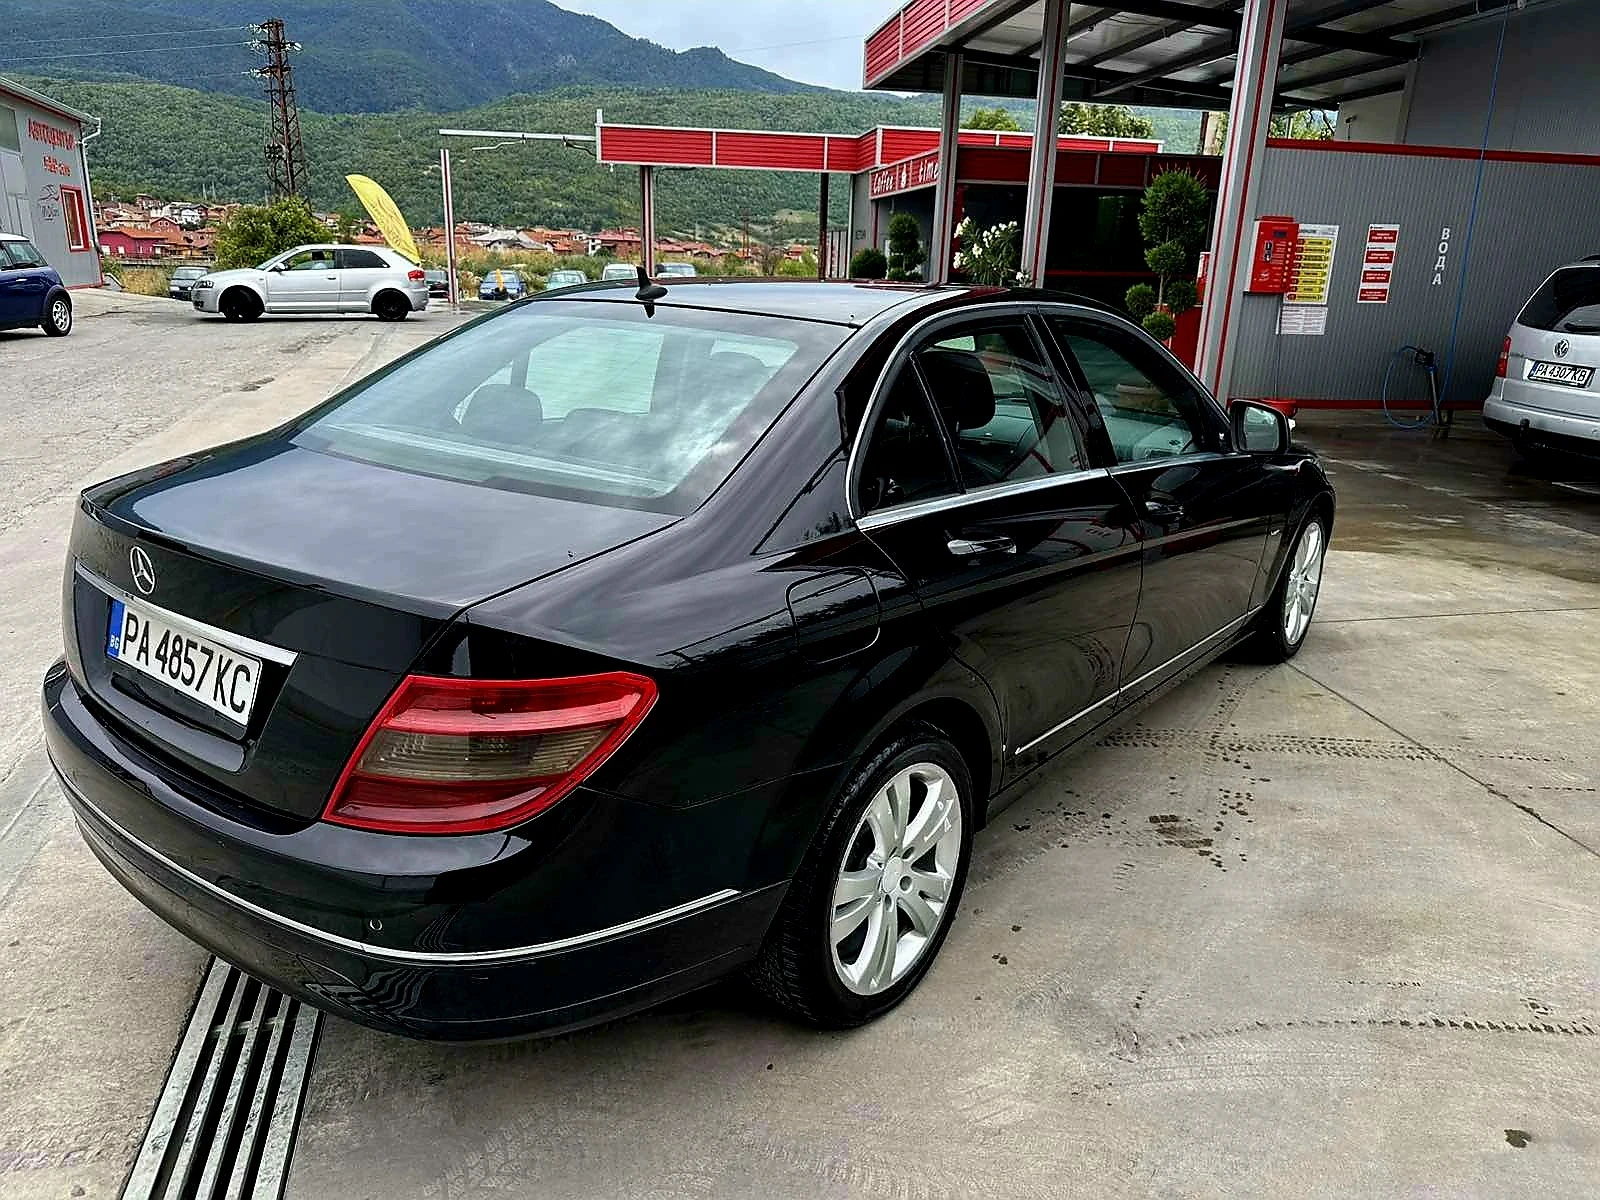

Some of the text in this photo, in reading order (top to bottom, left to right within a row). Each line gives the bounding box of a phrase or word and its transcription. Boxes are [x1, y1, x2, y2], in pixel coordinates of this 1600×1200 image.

[1432, 227, 1451, 285] ВОДА
[109, 633, 120, 650] BG
[121, 611, 251, 714] PA 4857 KC
